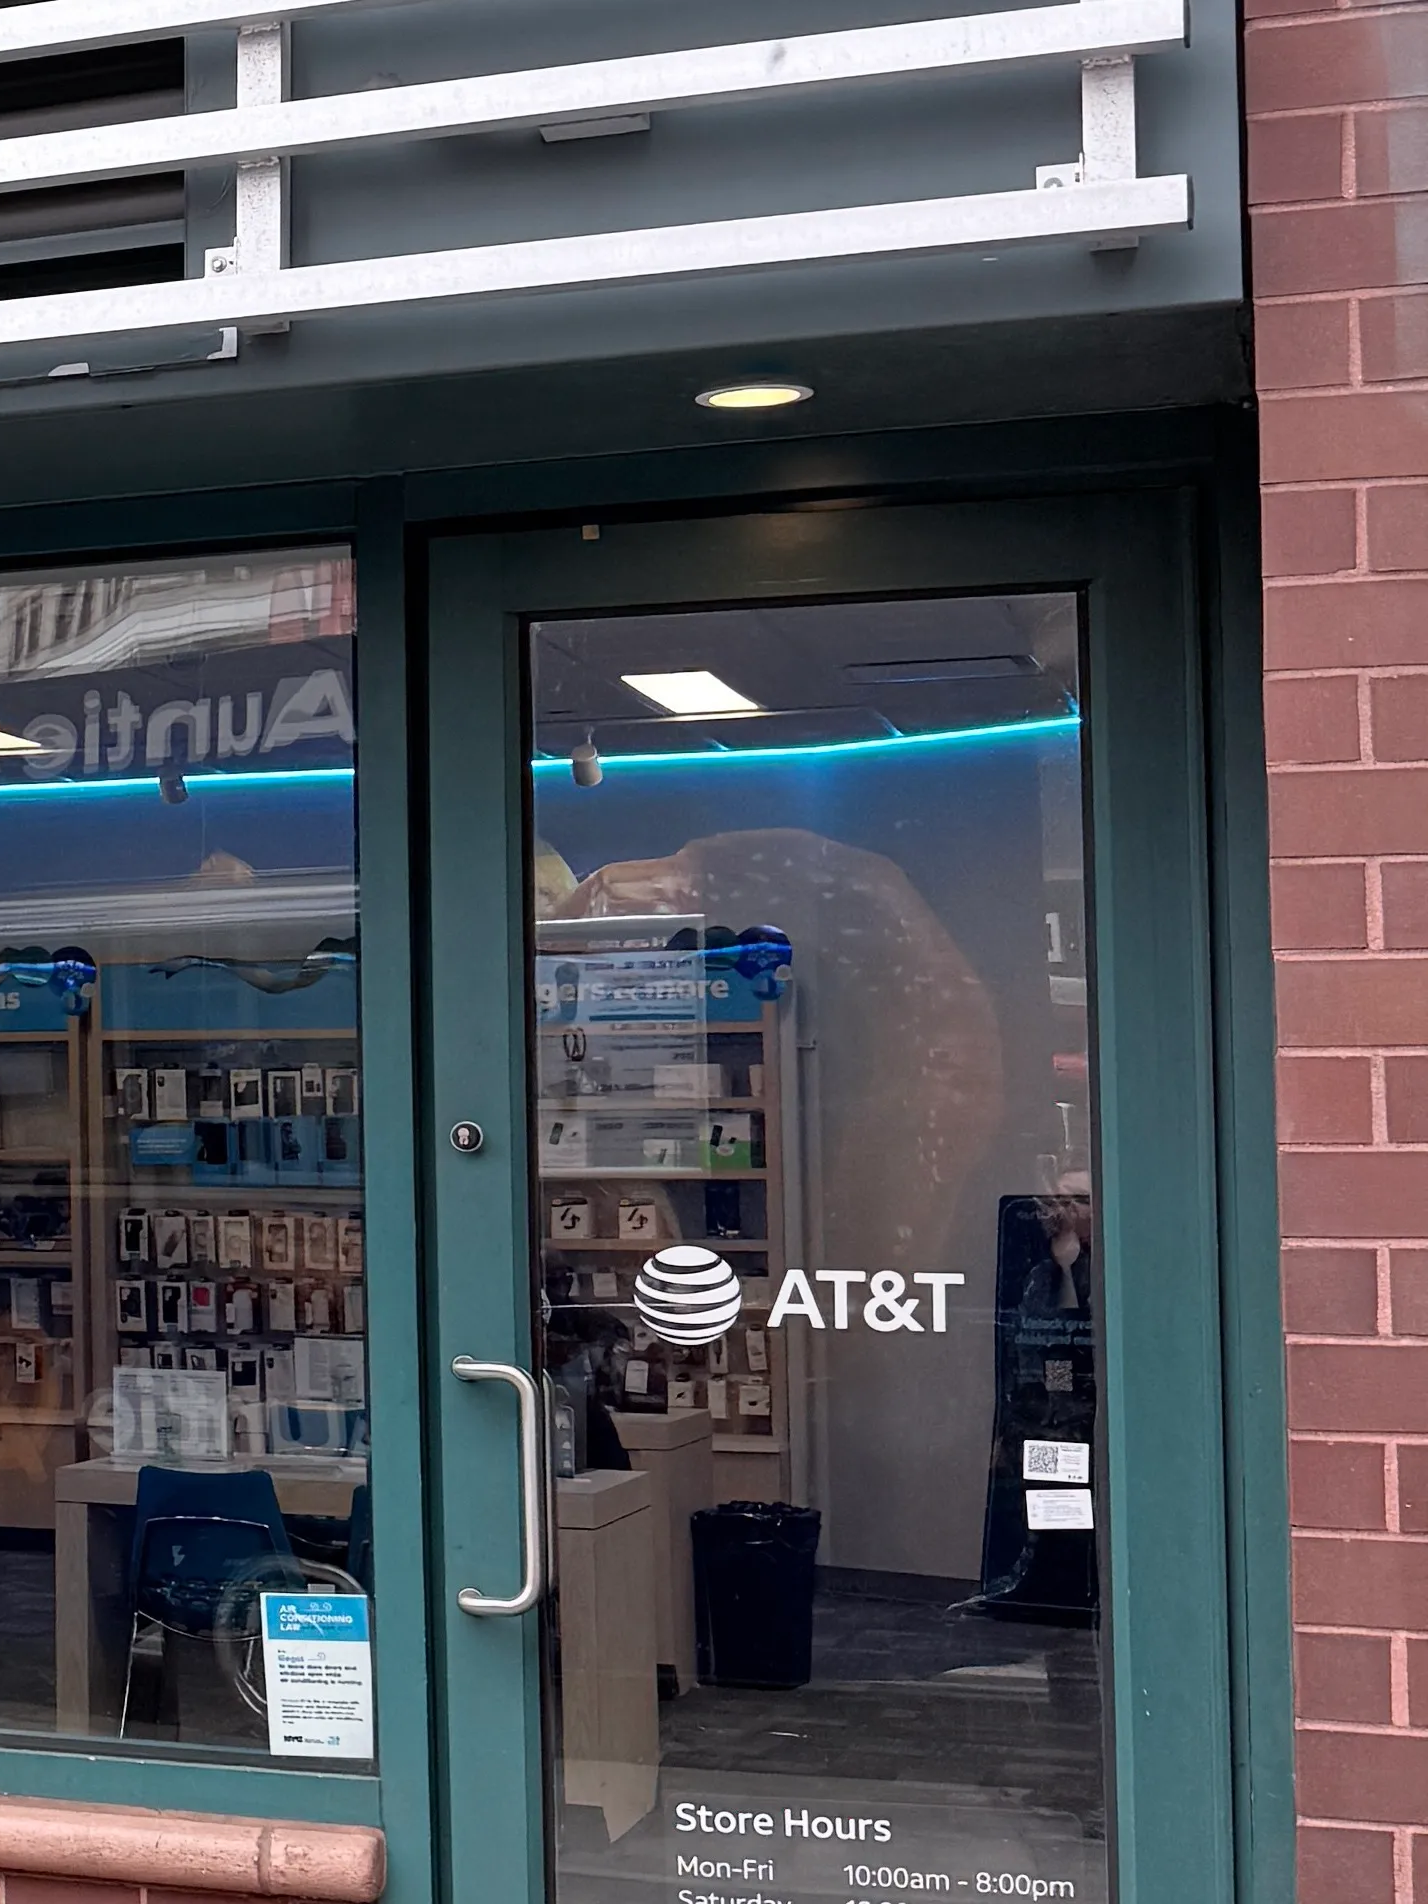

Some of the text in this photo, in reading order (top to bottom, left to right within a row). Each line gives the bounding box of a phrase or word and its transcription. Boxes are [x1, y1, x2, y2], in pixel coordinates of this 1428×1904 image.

[765, 1268, 966, 1333] AT&T
[674, 1802, 892, 1843] Store Hours
[676, 1855, 775, 1882] Mon-Fri
[843, 1864, 950, 1893] 10:00am
[975, 1871, 1075, 1902] 8:00pm
